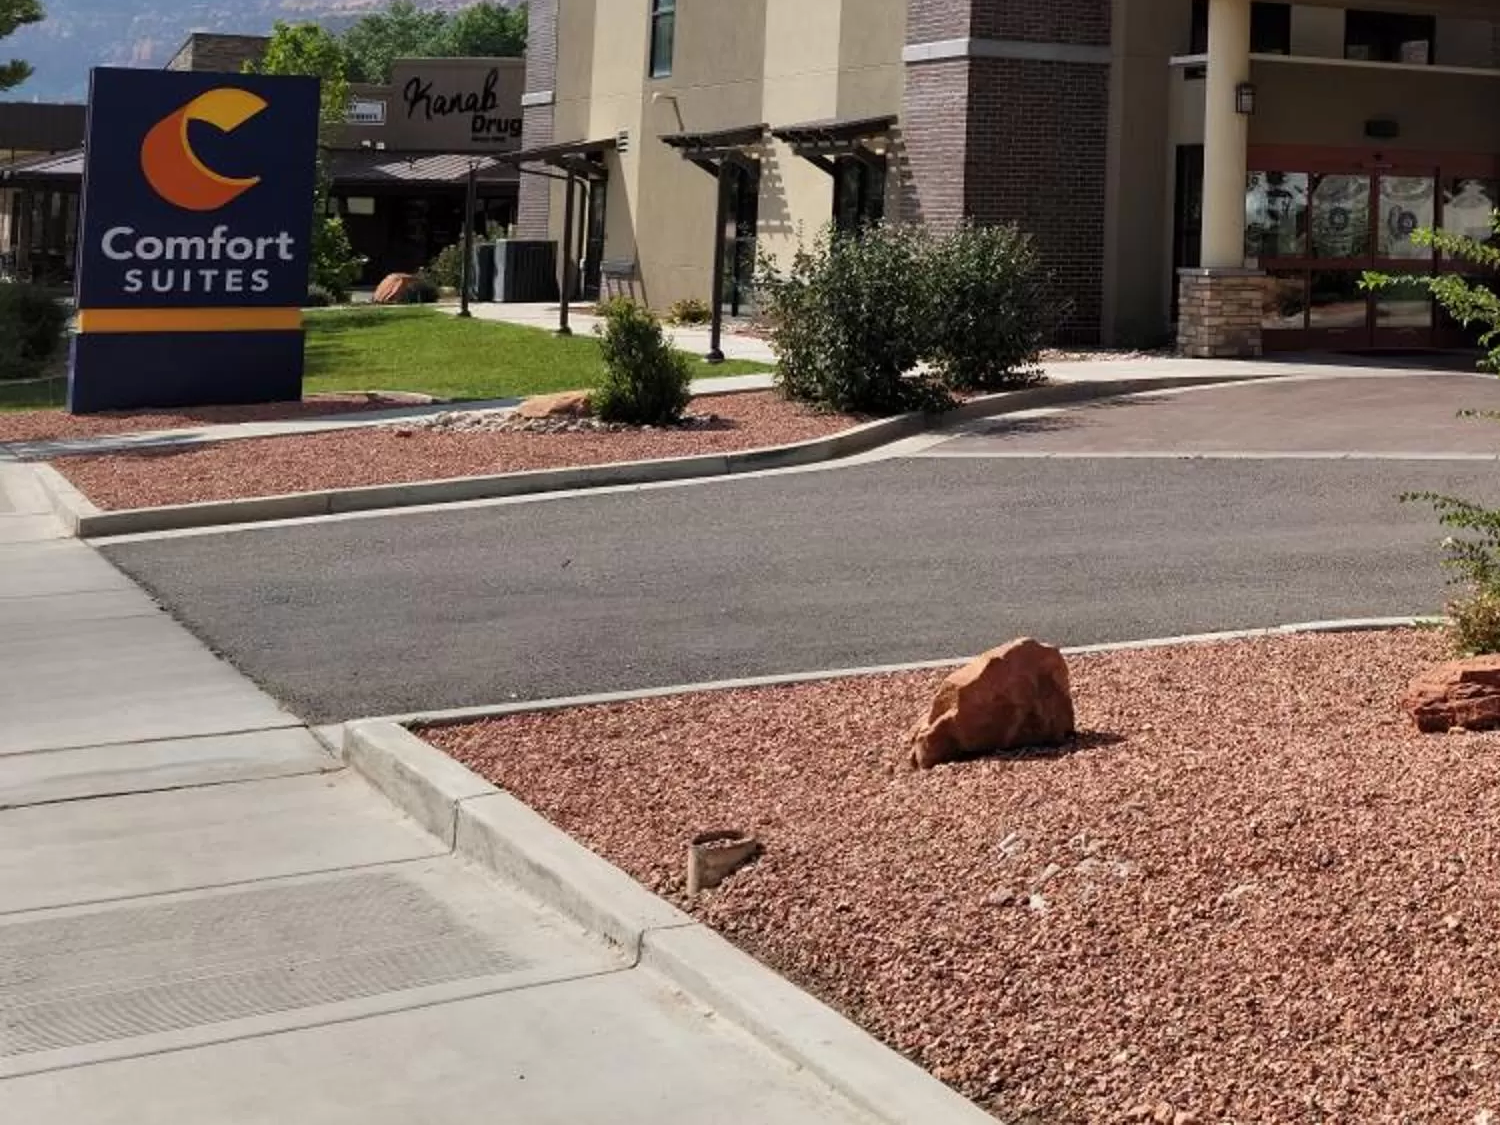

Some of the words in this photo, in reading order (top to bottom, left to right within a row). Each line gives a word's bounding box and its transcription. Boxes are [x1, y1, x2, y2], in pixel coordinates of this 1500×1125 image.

[404, 67, 499, 120] Kanab
[472, 114, 522, 137] Drug
[101, 225, 295, 261] Comfort
[123, 269, 269, 293] SUITES
